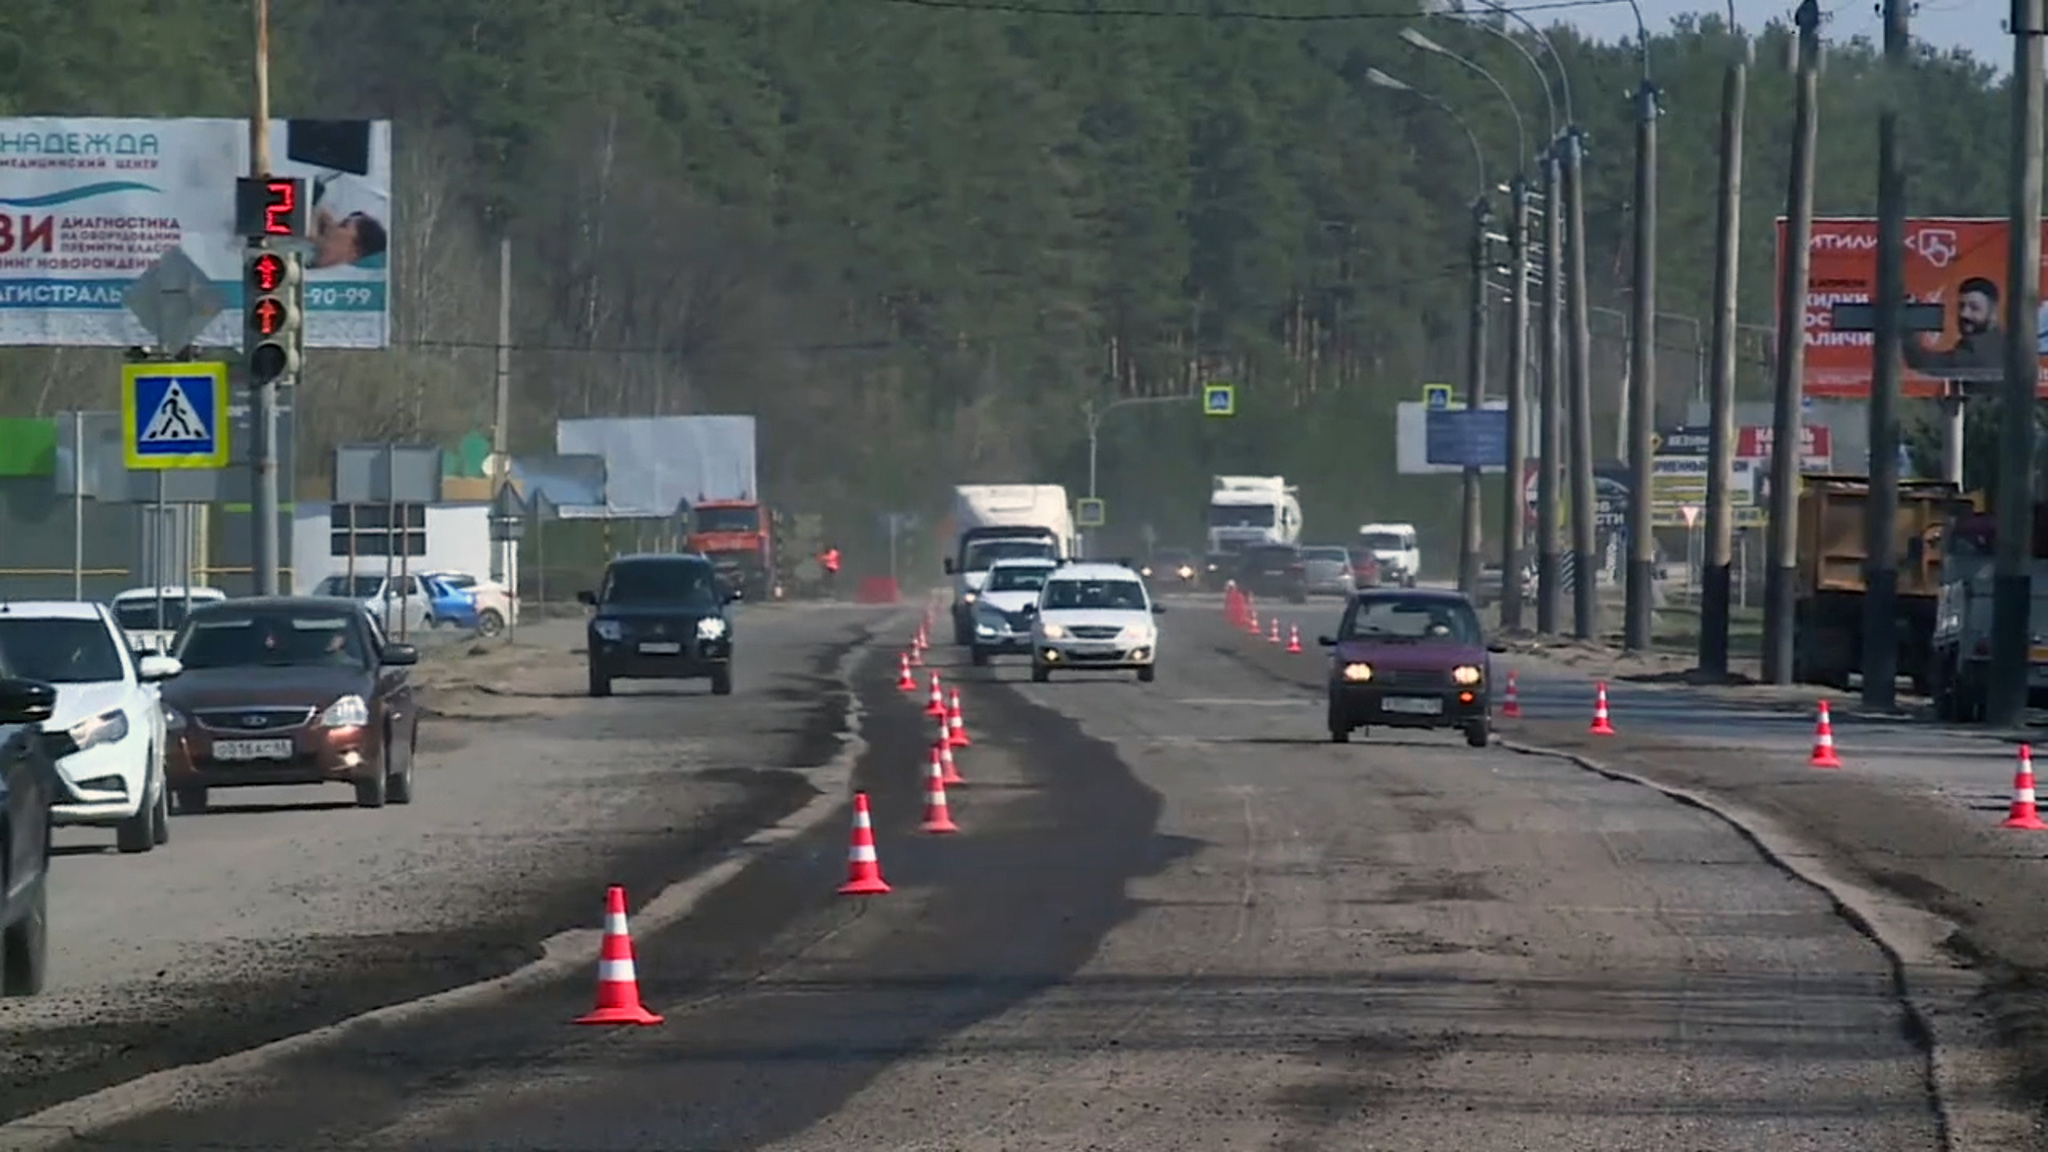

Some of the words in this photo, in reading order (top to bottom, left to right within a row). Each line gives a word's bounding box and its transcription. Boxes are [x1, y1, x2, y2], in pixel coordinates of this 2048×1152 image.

[0, 133, 159, 154] НАДЕЖДА
[115, 158, 159, 169] ЦЕНТР
[265, 182, 294, 234] 2
[60, 217, 181, 229] ДИАГНОСТИКА
[60, 231, 77, 241] НА
[60, 242, 124, 252] ПРЕМИУМ
